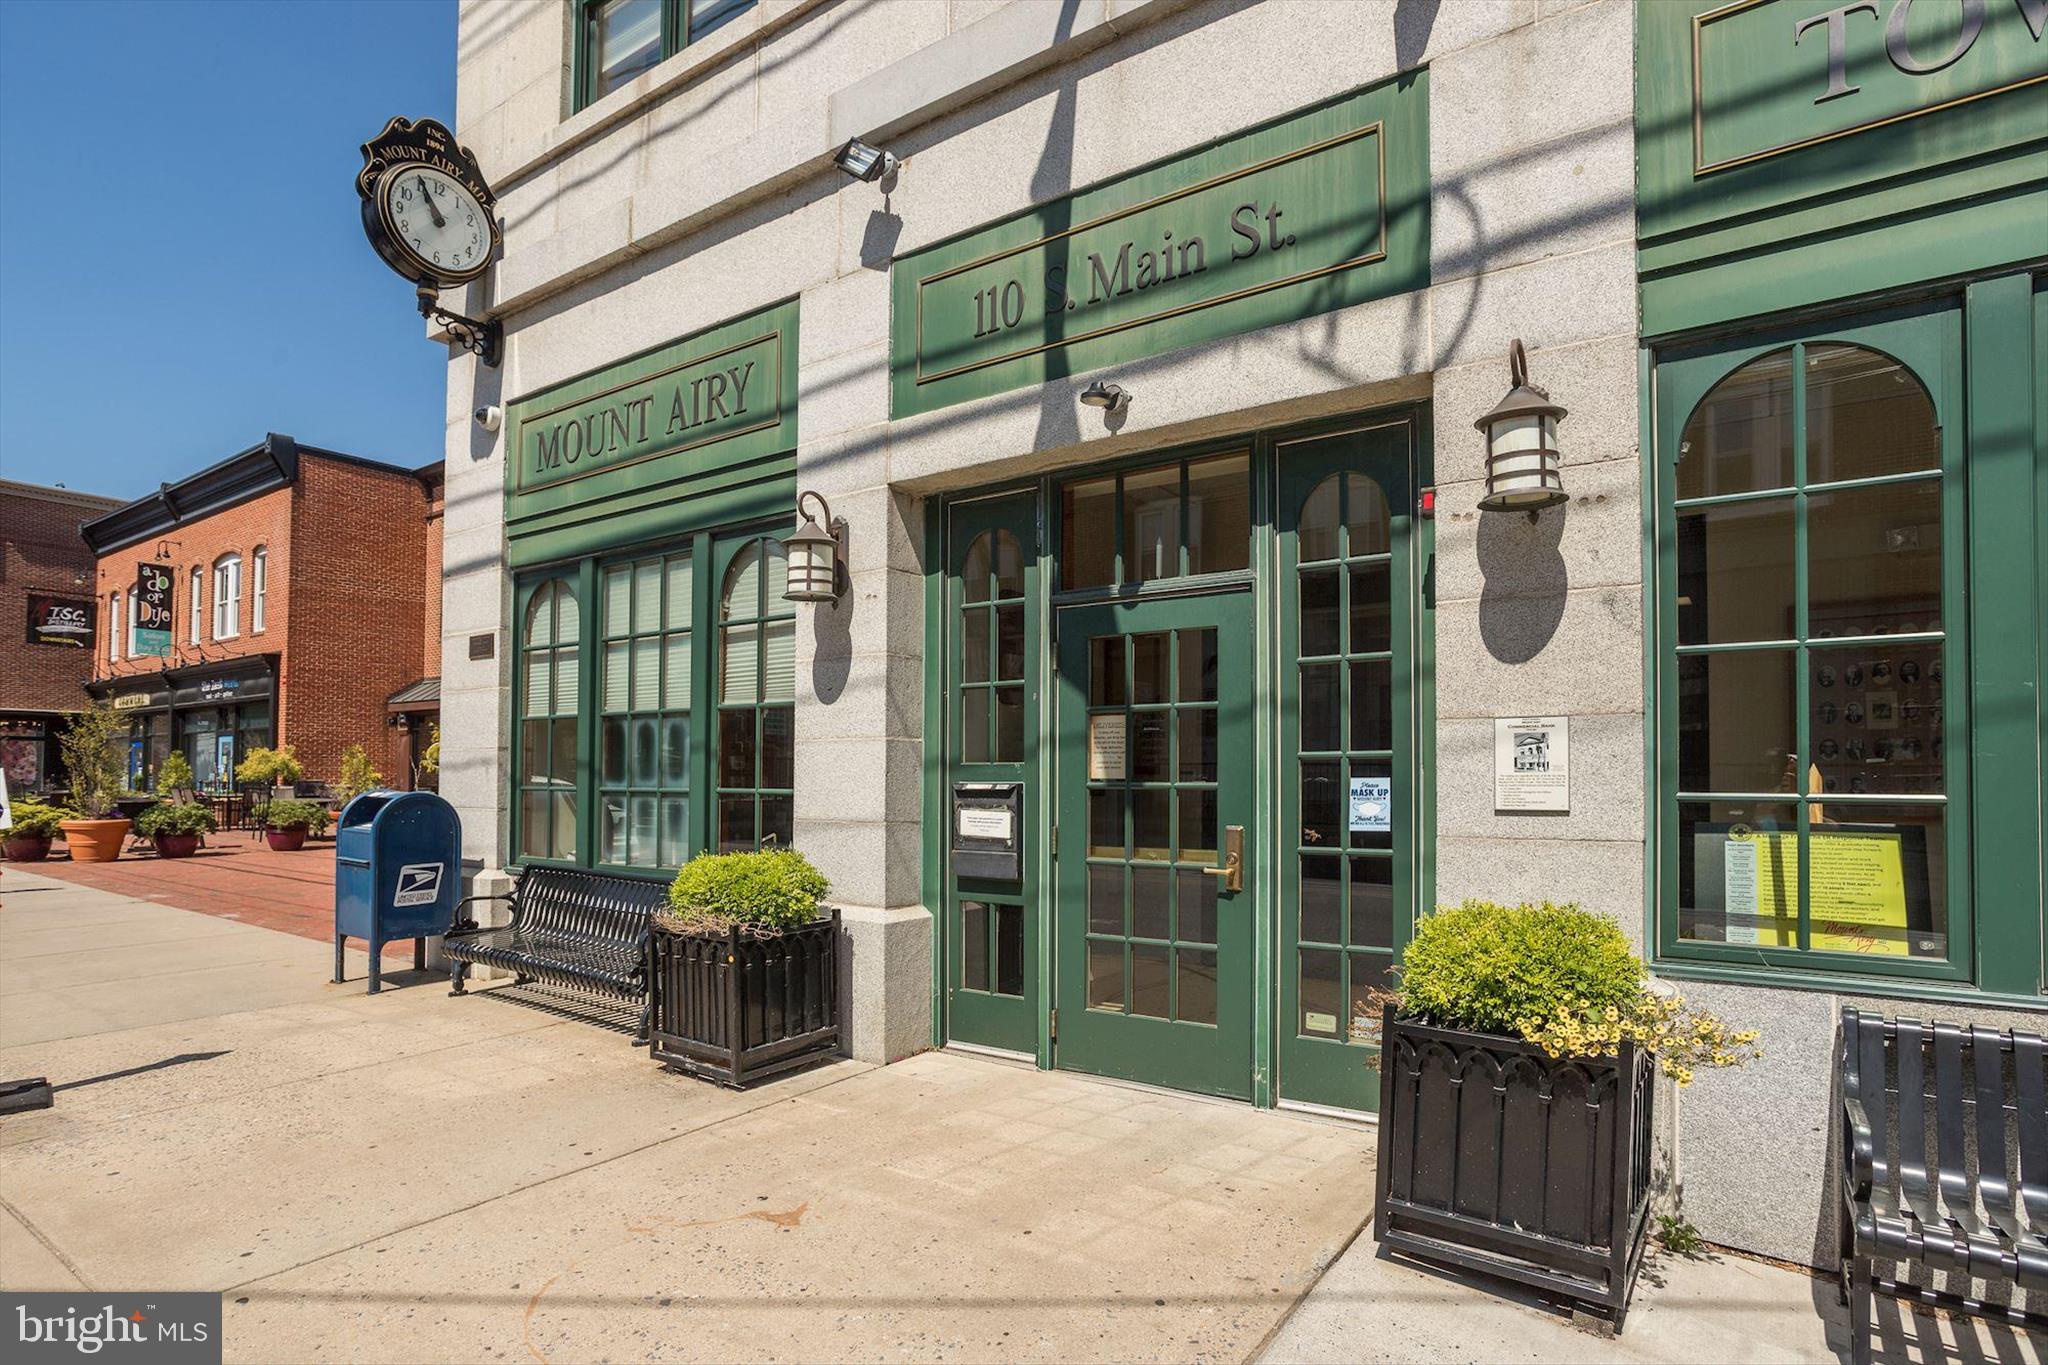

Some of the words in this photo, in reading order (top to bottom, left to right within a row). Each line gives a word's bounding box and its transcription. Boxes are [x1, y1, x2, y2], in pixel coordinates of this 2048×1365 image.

[379, 144, 428, 160] MOUNT
[431, 154, 464, 178] AIRY
[401, 186, 413, 201] 10
[433, 182, 447, 197] 12
[395, 201, 404, 214] 9
[455, 197, 460, 209] 1
[400, 219, 409, 234] 8
[466, 214, 474, 228] 2
[412, 238, 421, 251] 7
[471, 232, 479, 245] 3
[433, 250, 441, 264] 6
[465, 246, 473, 259] 4
[451, 254, 461, 267] 5
[973, 279, 1025, 338] 110
[1044, 264, 1076, 317] S.
[1087, 230, 1208, 305] Main
[1230, 199, 1297, 262] St.
[535, 394, 654, 473] MOUNT
[665, 361, 755, 435] AIRY
[147, 592, 163, 604] or
[139, 600, 170, 628] Dye
[1350, 788, 1375, 797] MASK
[1377, 788, 1389, 797] UP
